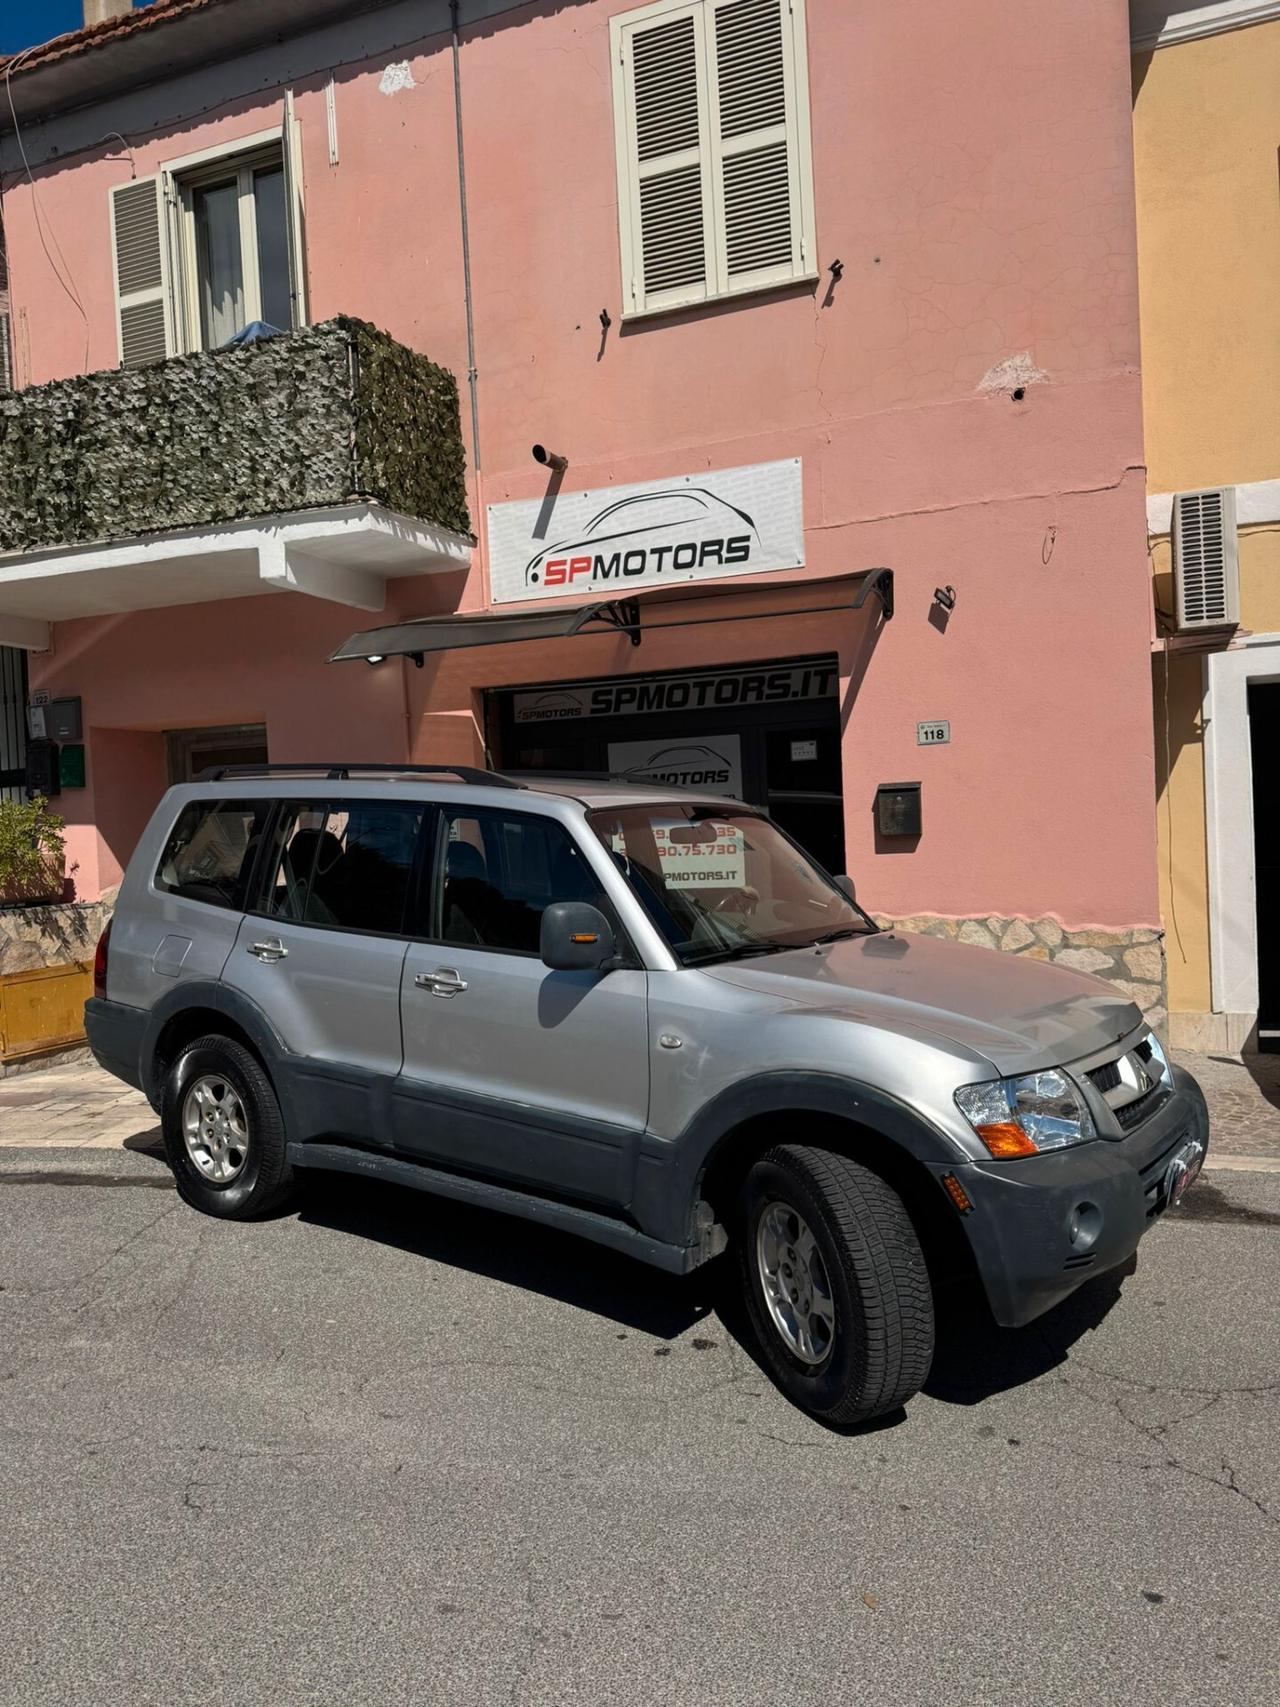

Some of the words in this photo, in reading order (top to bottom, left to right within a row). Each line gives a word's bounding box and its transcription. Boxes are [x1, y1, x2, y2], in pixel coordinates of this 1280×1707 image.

[543, 535, 751, 586] SPMOTORS
[590, 669, 837, 714] SPMOTORS.IT
[522, 708, 582, 720] SPMOTORS
[923, 729, 944, 740] 118
[663, 871, 737, 882] PMOTORS.IT
